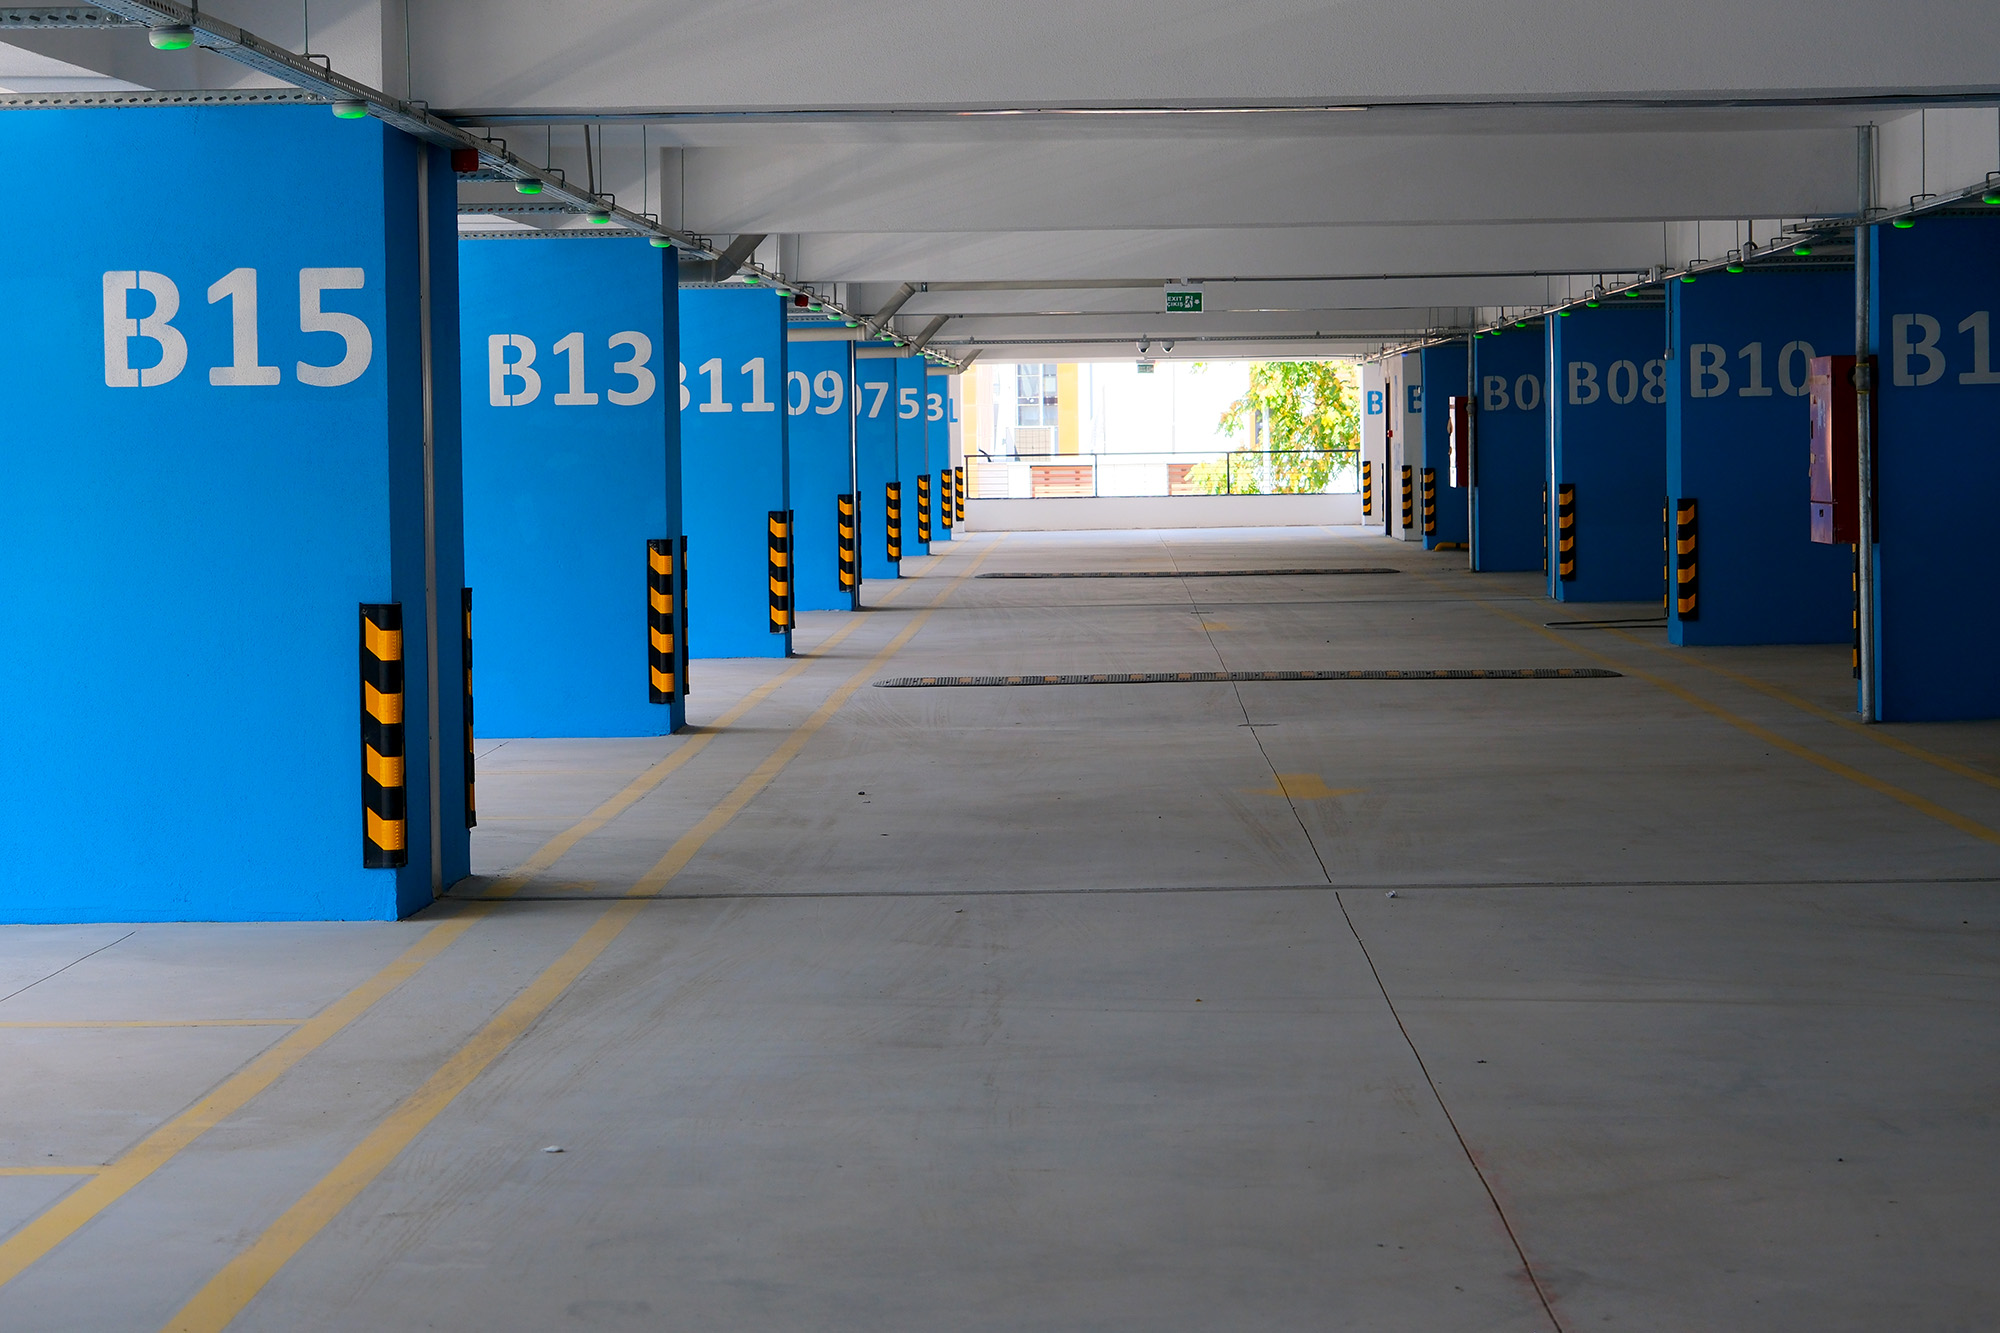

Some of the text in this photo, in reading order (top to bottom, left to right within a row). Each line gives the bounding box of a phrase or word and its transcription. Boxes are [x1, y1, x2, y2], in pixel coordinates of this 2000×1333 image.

[102, 267, 373, 388] B15
[488, 330, 656, 407] B13
[1690, 340, 1816, 398] B10
[1892, 310, 2000, 387] B1
[856, 382, 889, 418] 7
[1367, 390, 1383, 415] B
[1483, 374, 1547, 411] B0
[1568, 359, 1667, 405] B08
[899, 388, 920, 419] 5
[927, 393, 944, 421] 3
